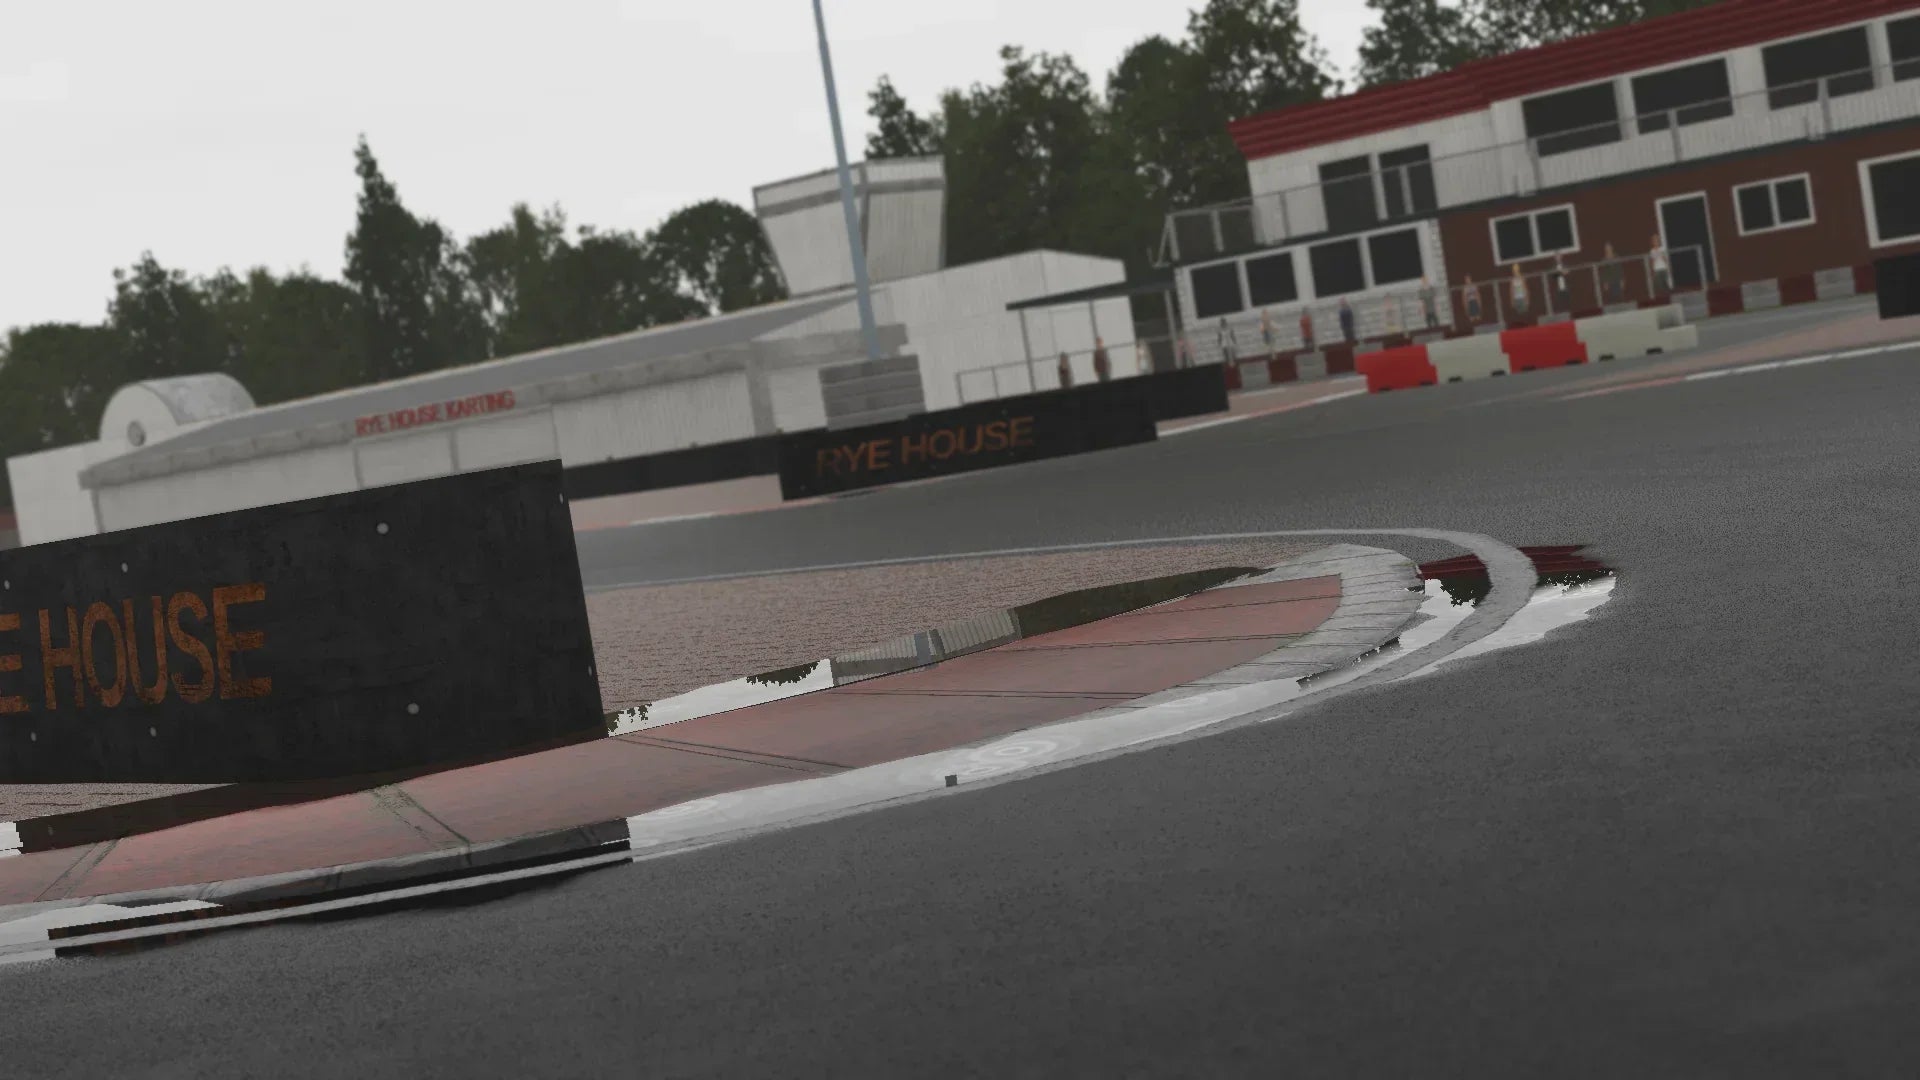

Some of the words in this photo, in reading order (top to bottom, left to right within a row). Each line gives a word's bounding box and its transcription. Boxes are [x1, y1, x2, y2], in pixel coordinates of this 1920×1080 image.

[355, 413, 386, 437] RYE
[389, 402, 442, 431] HOUSE
[444, 389, 517, 421] KARTING
[816, 439, 892, 477] RYE
[902, 416, 1035, 465] HOUSE
[38, 582, 273, 710] HOUSE
